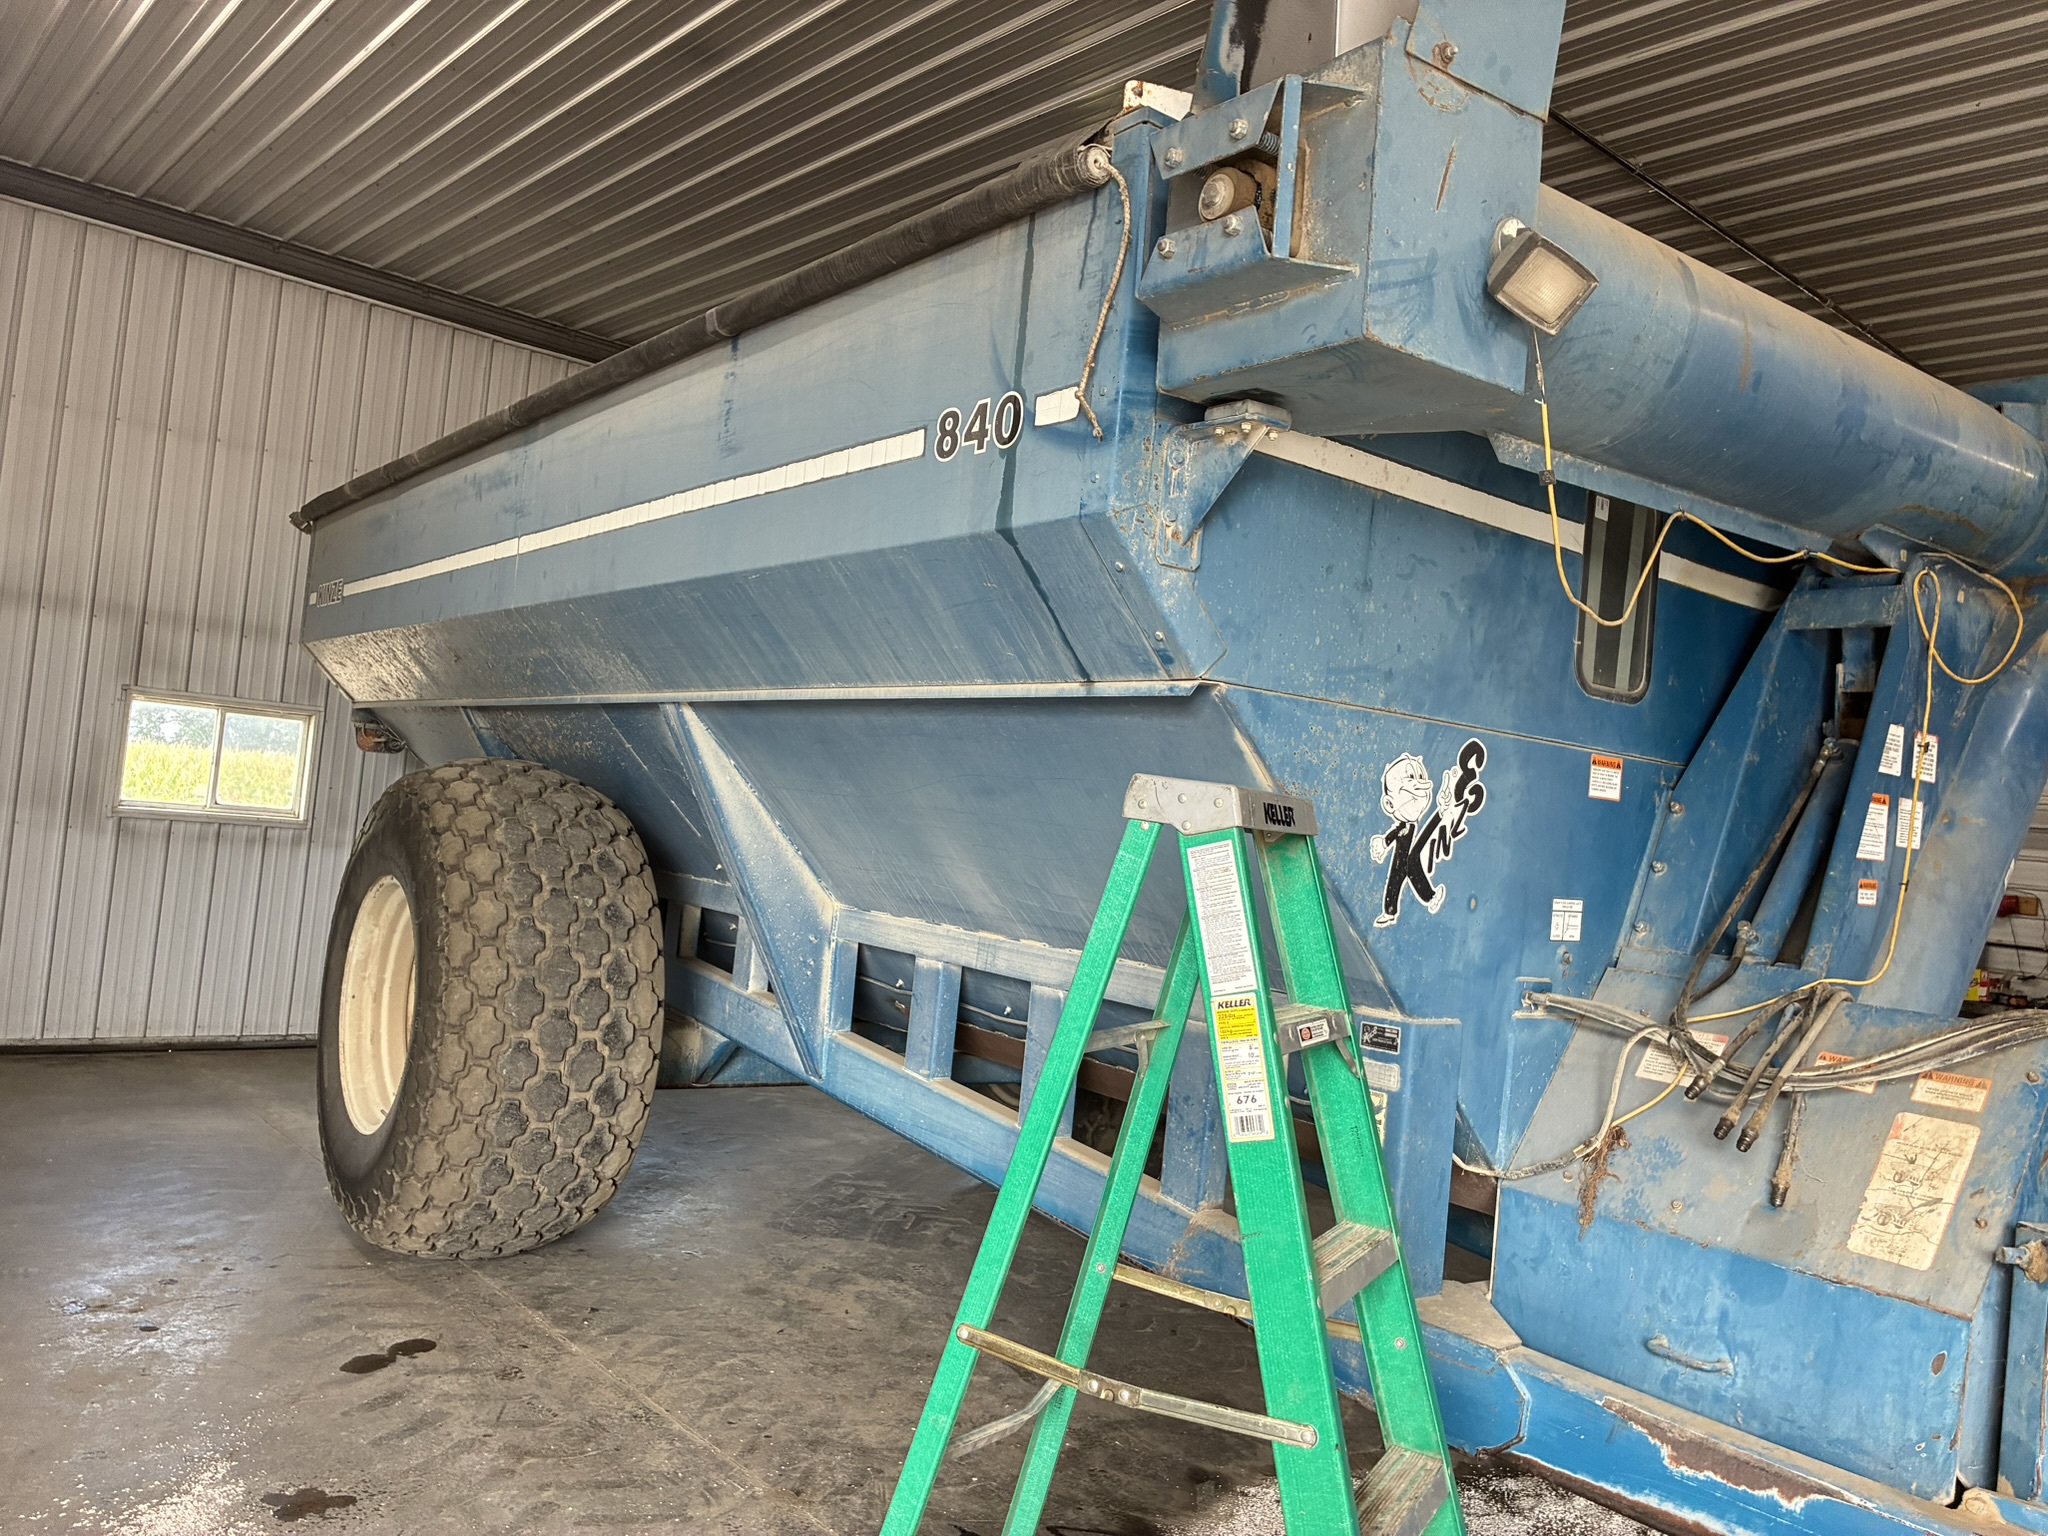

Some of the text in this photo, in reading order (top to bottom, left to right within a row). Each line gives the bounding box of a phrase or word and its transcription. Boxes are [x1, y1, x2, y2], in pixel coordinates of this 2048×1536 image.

[934, 391, 1023, 462] 840
[1597, 759, 1616, 769] WARNING
[1263, 801, 1296, 828] KELLER
[1217, 998, 1251, 1009] KELLER
[1934, 1073, 1975, 1086] WARNING
[1236, 1095, 1257, 1105] 676
